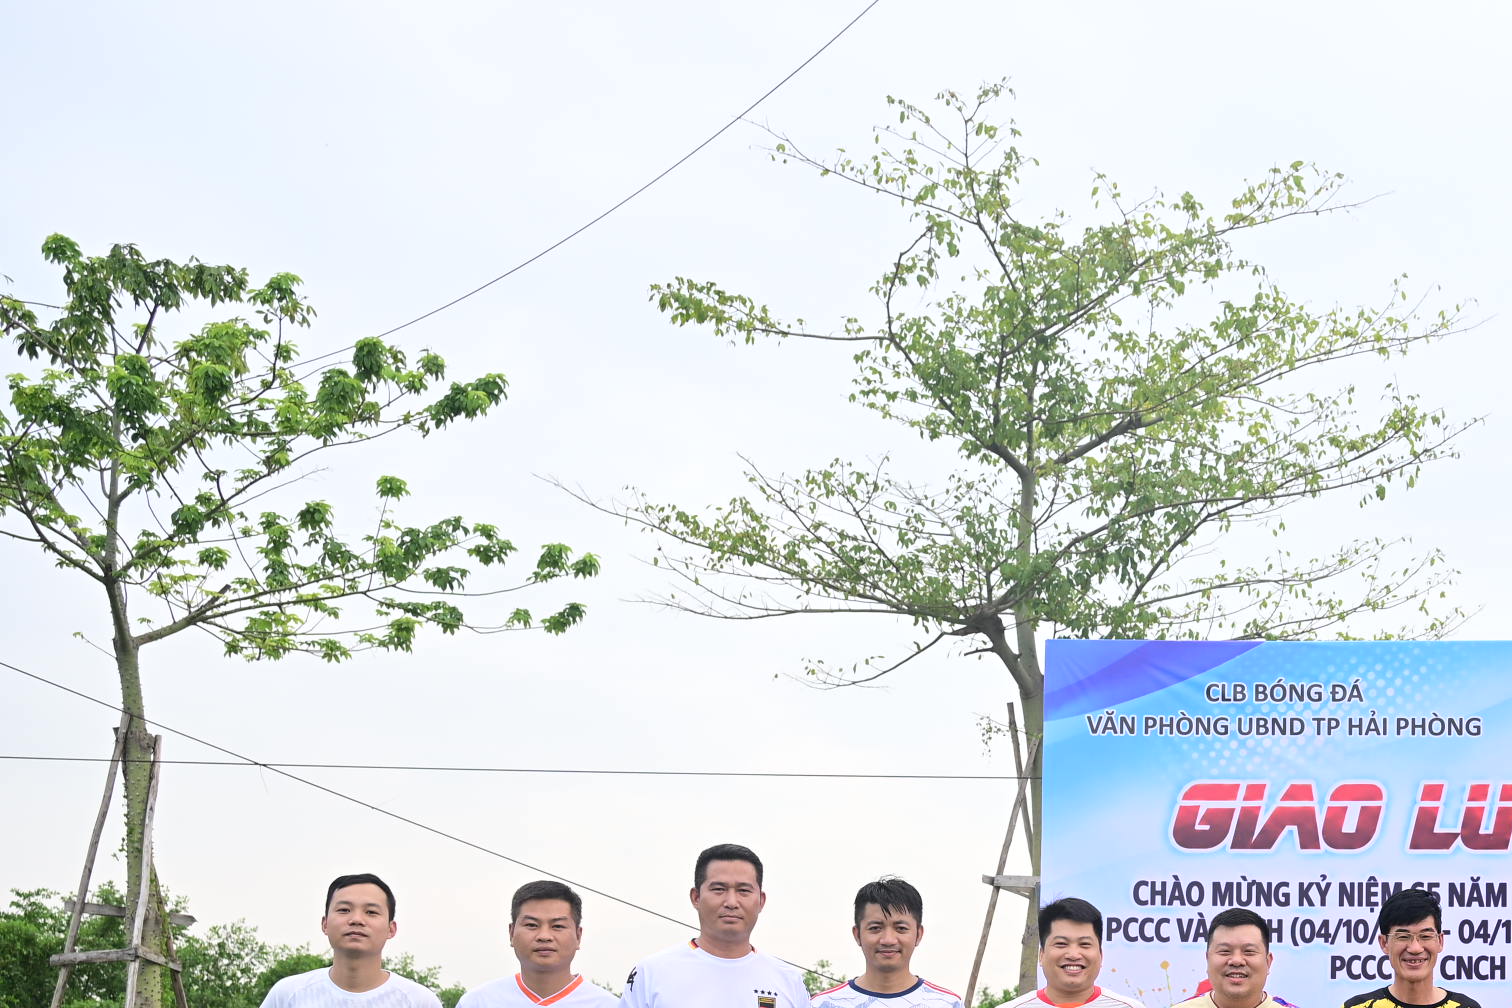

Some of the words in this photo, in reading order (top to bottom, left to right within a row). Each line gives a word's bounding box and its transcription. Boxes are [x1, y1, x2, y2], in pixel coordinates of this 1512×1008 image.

[1205, 683, 1247, 702] CLB
[1254, 678, 1323, 703] BÓNG
[1329, 678, 1364, 702] ĐÁ
[1086, 710, 1135, 735] VĂN
[1144, 711, 1229, 736] PHÒNG
[1237, 717, 1305, 736] UBND
[1311, 717, 1341, 736] TP
[1348, 710, 1388, 736] HẢI
[1396, 711, 1482, 737] PHÒNG
[1172, 783, 1384, 850] GIAO
[1132, 874, 1205, 907] CHÀO
[1211, 875, 1291, 908] MỪNG
[1298, 873, 1333, 907] KỶ
[1338, 875, 1403, 913] NIỆM
[1447, 876, 1508, 908] NĂM
[1105, 917, 1171, 943] PCCC
[1176, 911, 1209, 943] VÀ
[1330, 955, 1392, 981] PCCC
[1439, 955, 1506, 981] CNCH
